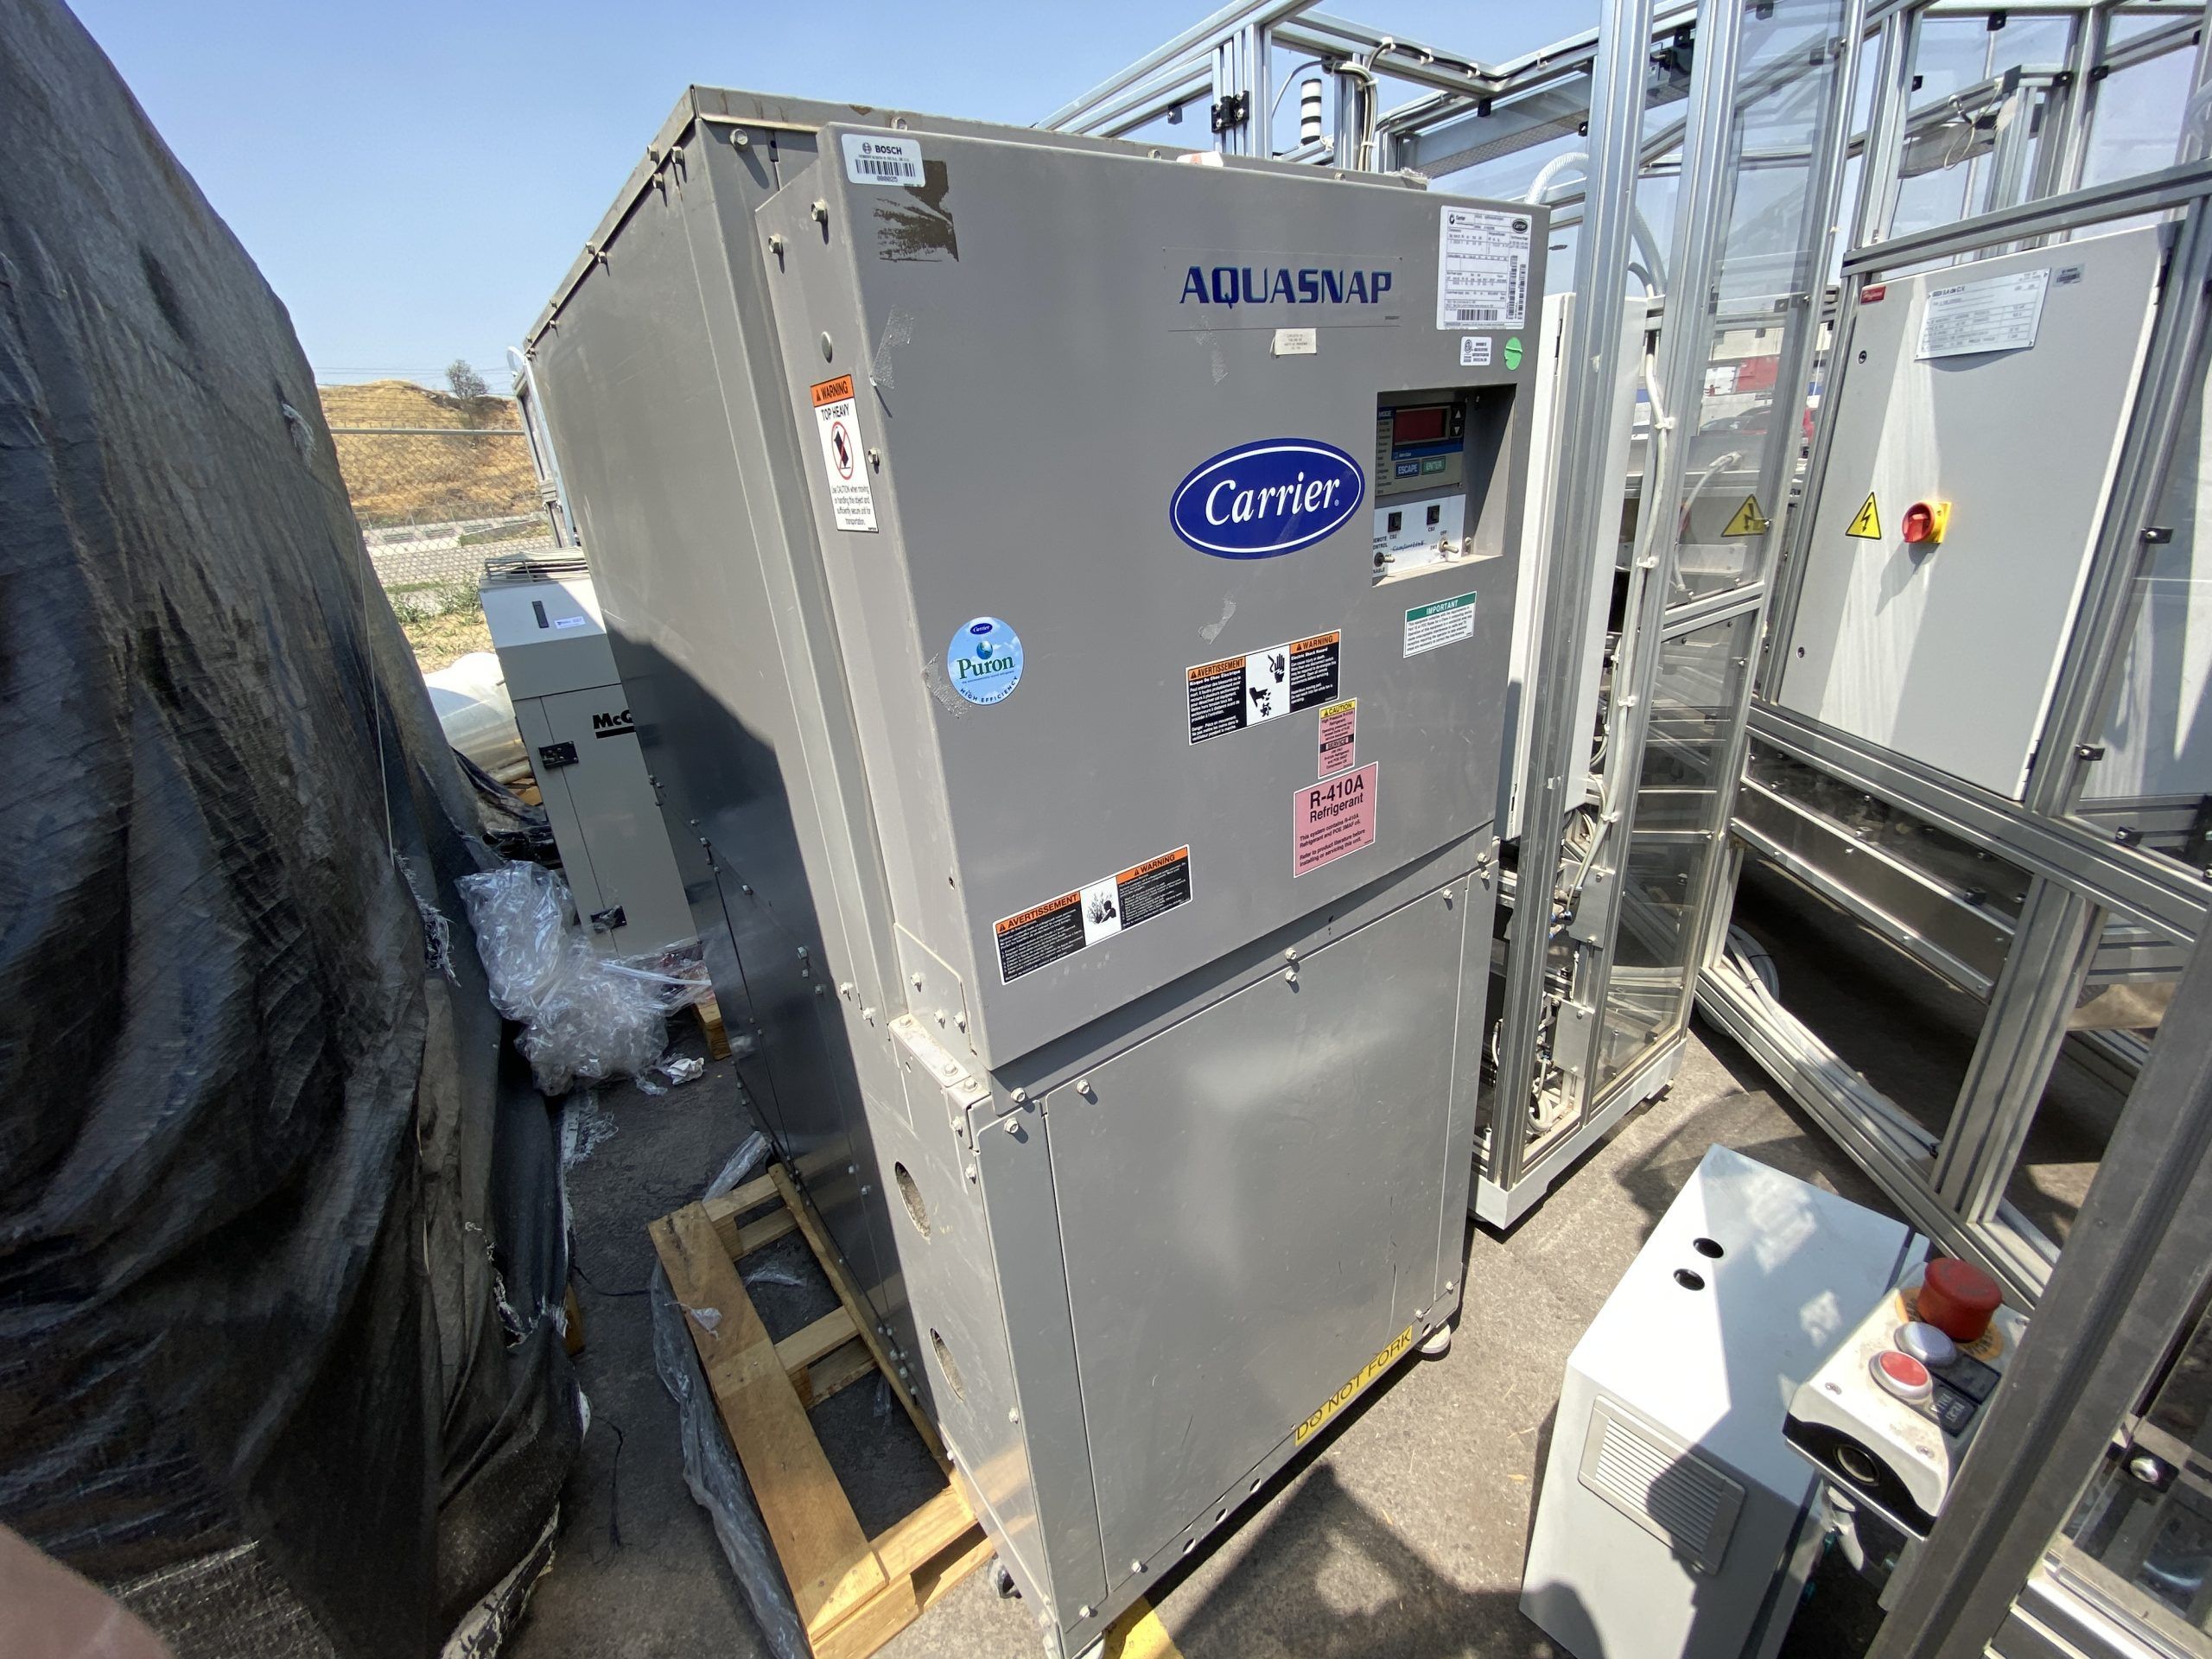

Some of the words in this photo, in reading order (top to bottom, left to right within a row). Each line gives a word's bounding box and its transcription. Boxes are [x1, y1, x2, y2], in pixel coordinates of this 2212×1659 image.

[874, 145, 902, 155] BOSCH
[1179, 266, 1392, 309] AQUASNAP
[821, 381, 849, 399] WARNING
[821, 408, 832, 421] TOP
[832, 404, 849, 419] HEAVY
[1398, 464, 1417, 474] ESCAPE
[1426, 461, 1442, 470] ENTER
[1205, 472, 1339, 525] Carrier
[1426, 600, 1459, 615] IMPORTANT
[1303, 636, 1332, 650] WARNING
[957, 656, 1014, 679] Puron
[1198, 658, 1243, 677] AVERTISSEMENT
[960, 688, 978, 702] HIGH
[982, 676, 1018, 702] EFFICIENCY
[1330, 702, 1351, 714] CAUTION
[1328, 738, 1346, 749] SERVICE
[1310, 774, 1363, 809] R-410A
[1310, 792, 1363, 823] Refrigerant
[1311, 827, 1325, 838] system
[1326, 819, 1343, 830] contains
[1344, 813, 1358, 823] R-410A
[1300, 835, 1323, 849] Refrigerant
[1318, 842, 1332, 854] product
[1335, 835, 1351, 846] literature
[1353, 830, 1364, 838] before
[1326, 844, 1343, 856] servicing
[1141, 854, 1175, 872] WARNING
[1007, 893, 1077, 928] AVERTISSEMENT
[1296, 1408, 1322, 1440] DO
[1329, 1369, 1363, 1412] NOT
[1368, 1328, 1410, 1377] FORK
